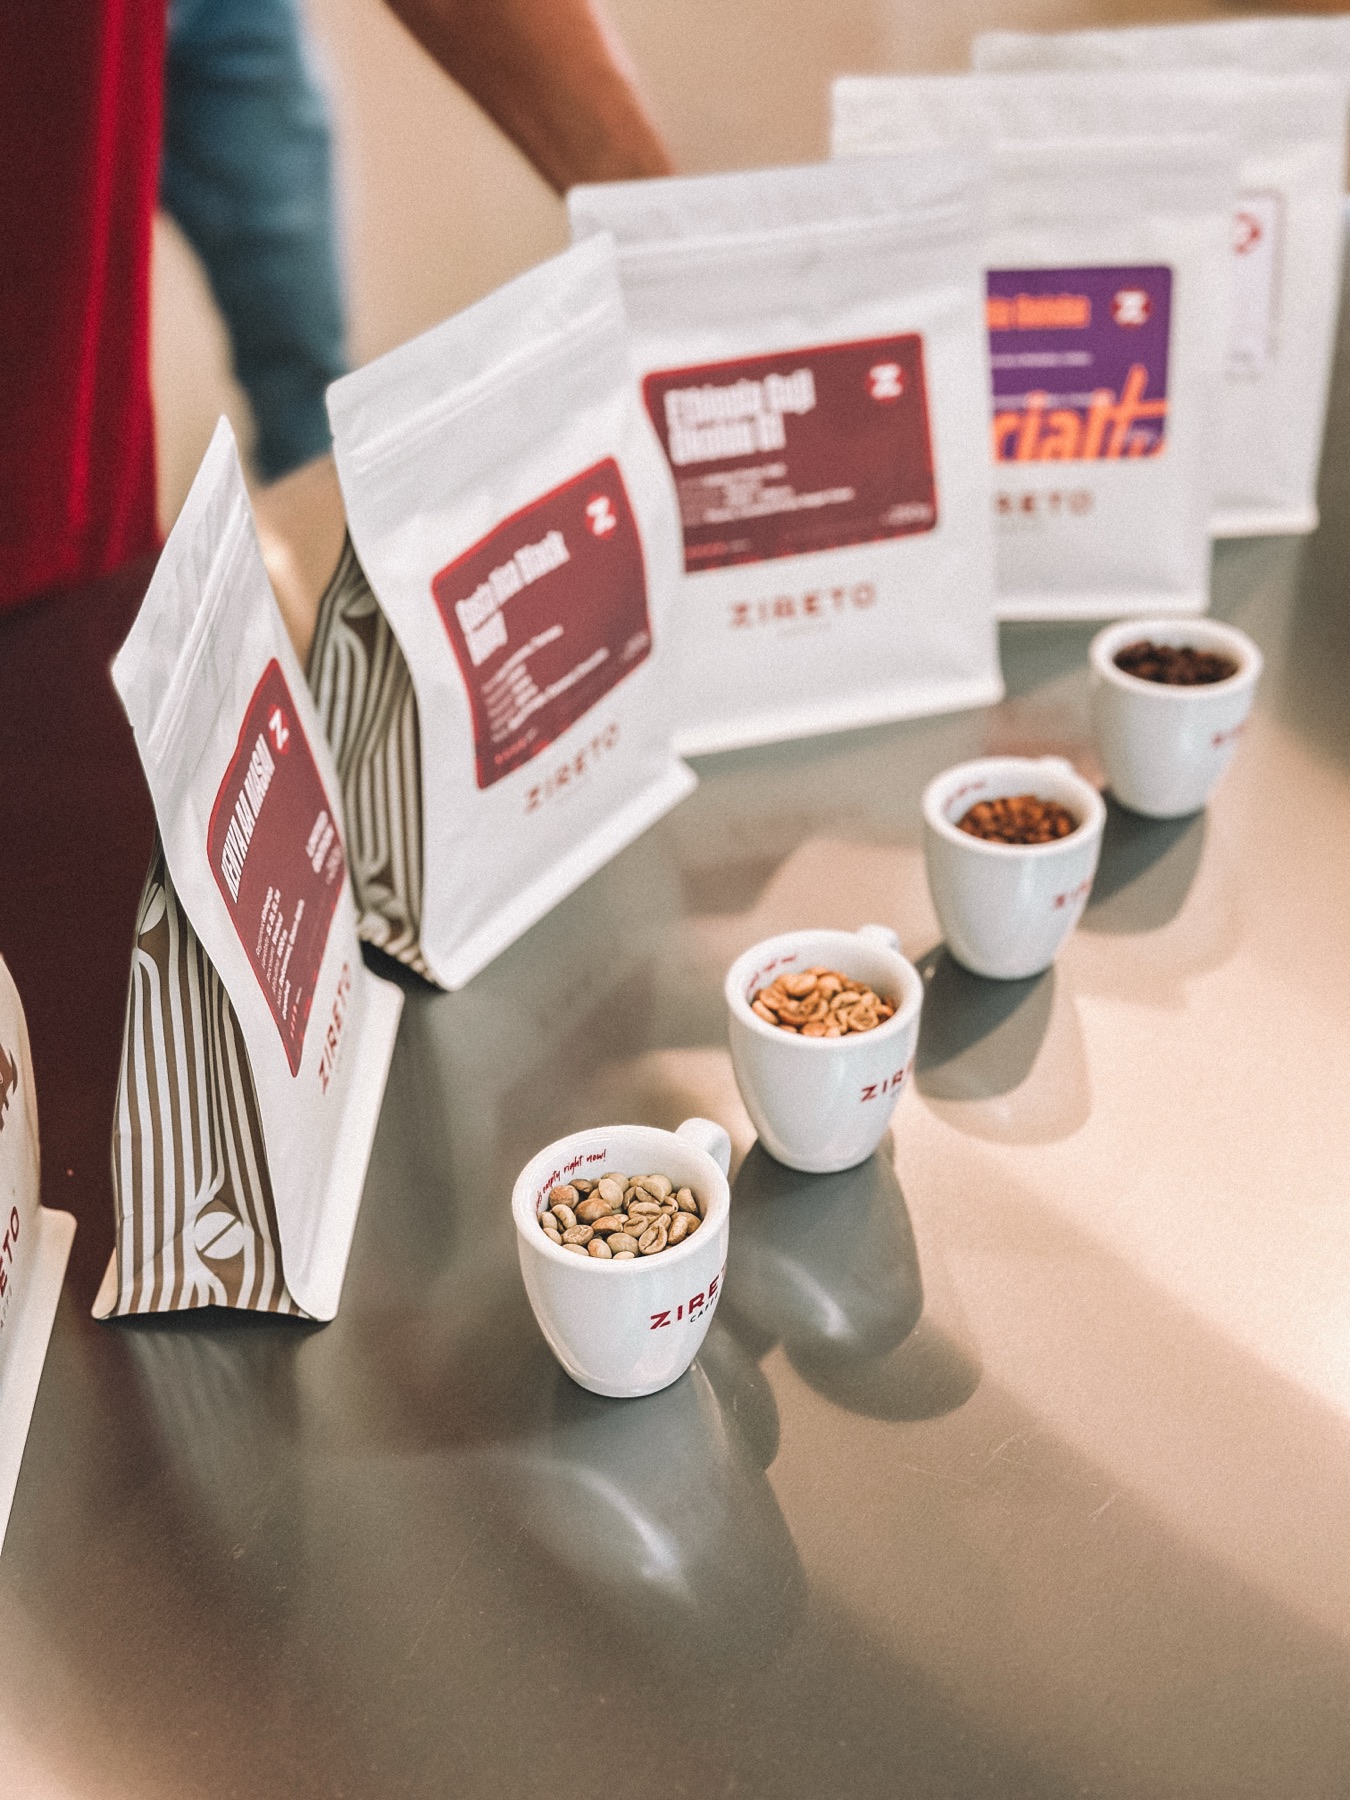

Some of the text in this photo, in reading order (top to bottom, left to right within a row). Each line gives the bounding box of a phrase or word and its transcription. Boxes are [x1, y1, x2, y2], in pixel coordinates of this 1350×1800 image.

[730, 581, 876, 629] ZIRETO
[221, 814, 249, 904] KENYA
[319, 961, 351, 1095] ZIRETO
[563, 1155, 584, 1175] right
[0, 1205, 20, 1298] ETO
